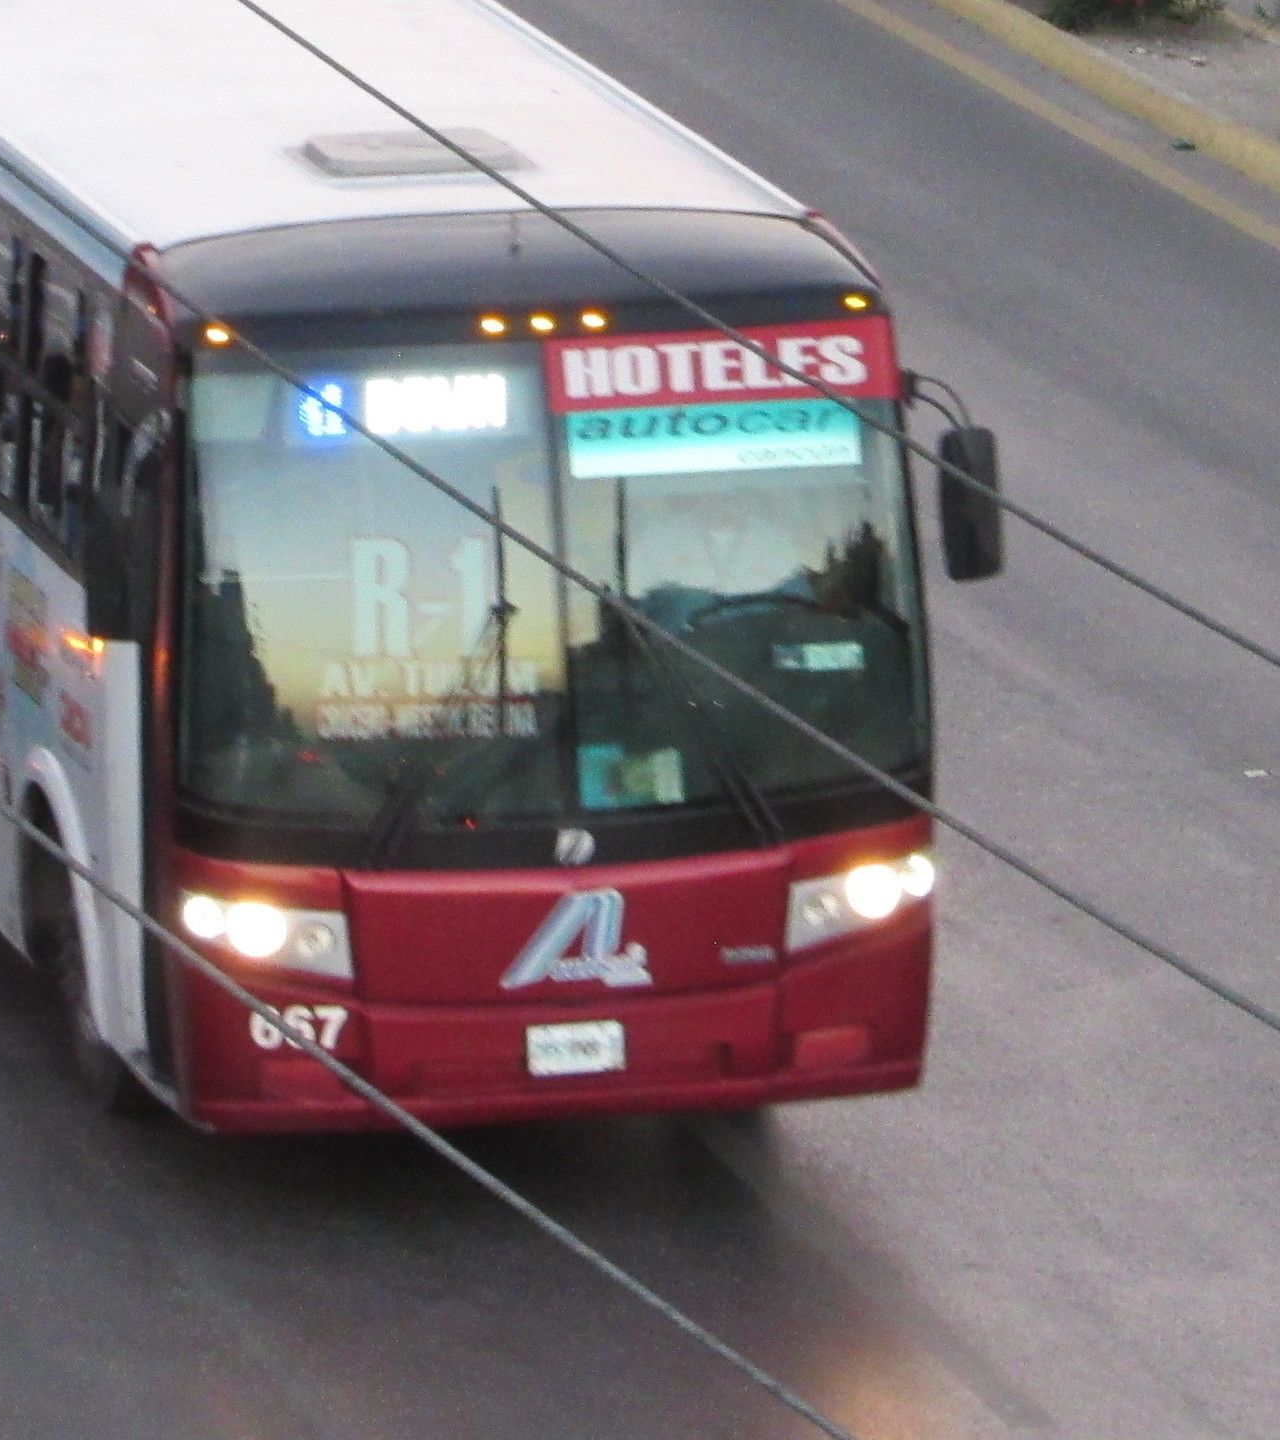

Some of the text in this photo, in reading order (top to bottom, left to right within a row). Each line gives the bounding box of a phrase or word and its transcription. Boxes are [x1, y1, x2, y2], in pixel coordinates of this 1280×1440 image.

[561, 334, 868, 399] HOTELES
[577, 408, 832, 442] autocar
[351, 536, 488, 657] R-1
[249, 1004, 348, 1050] 667
